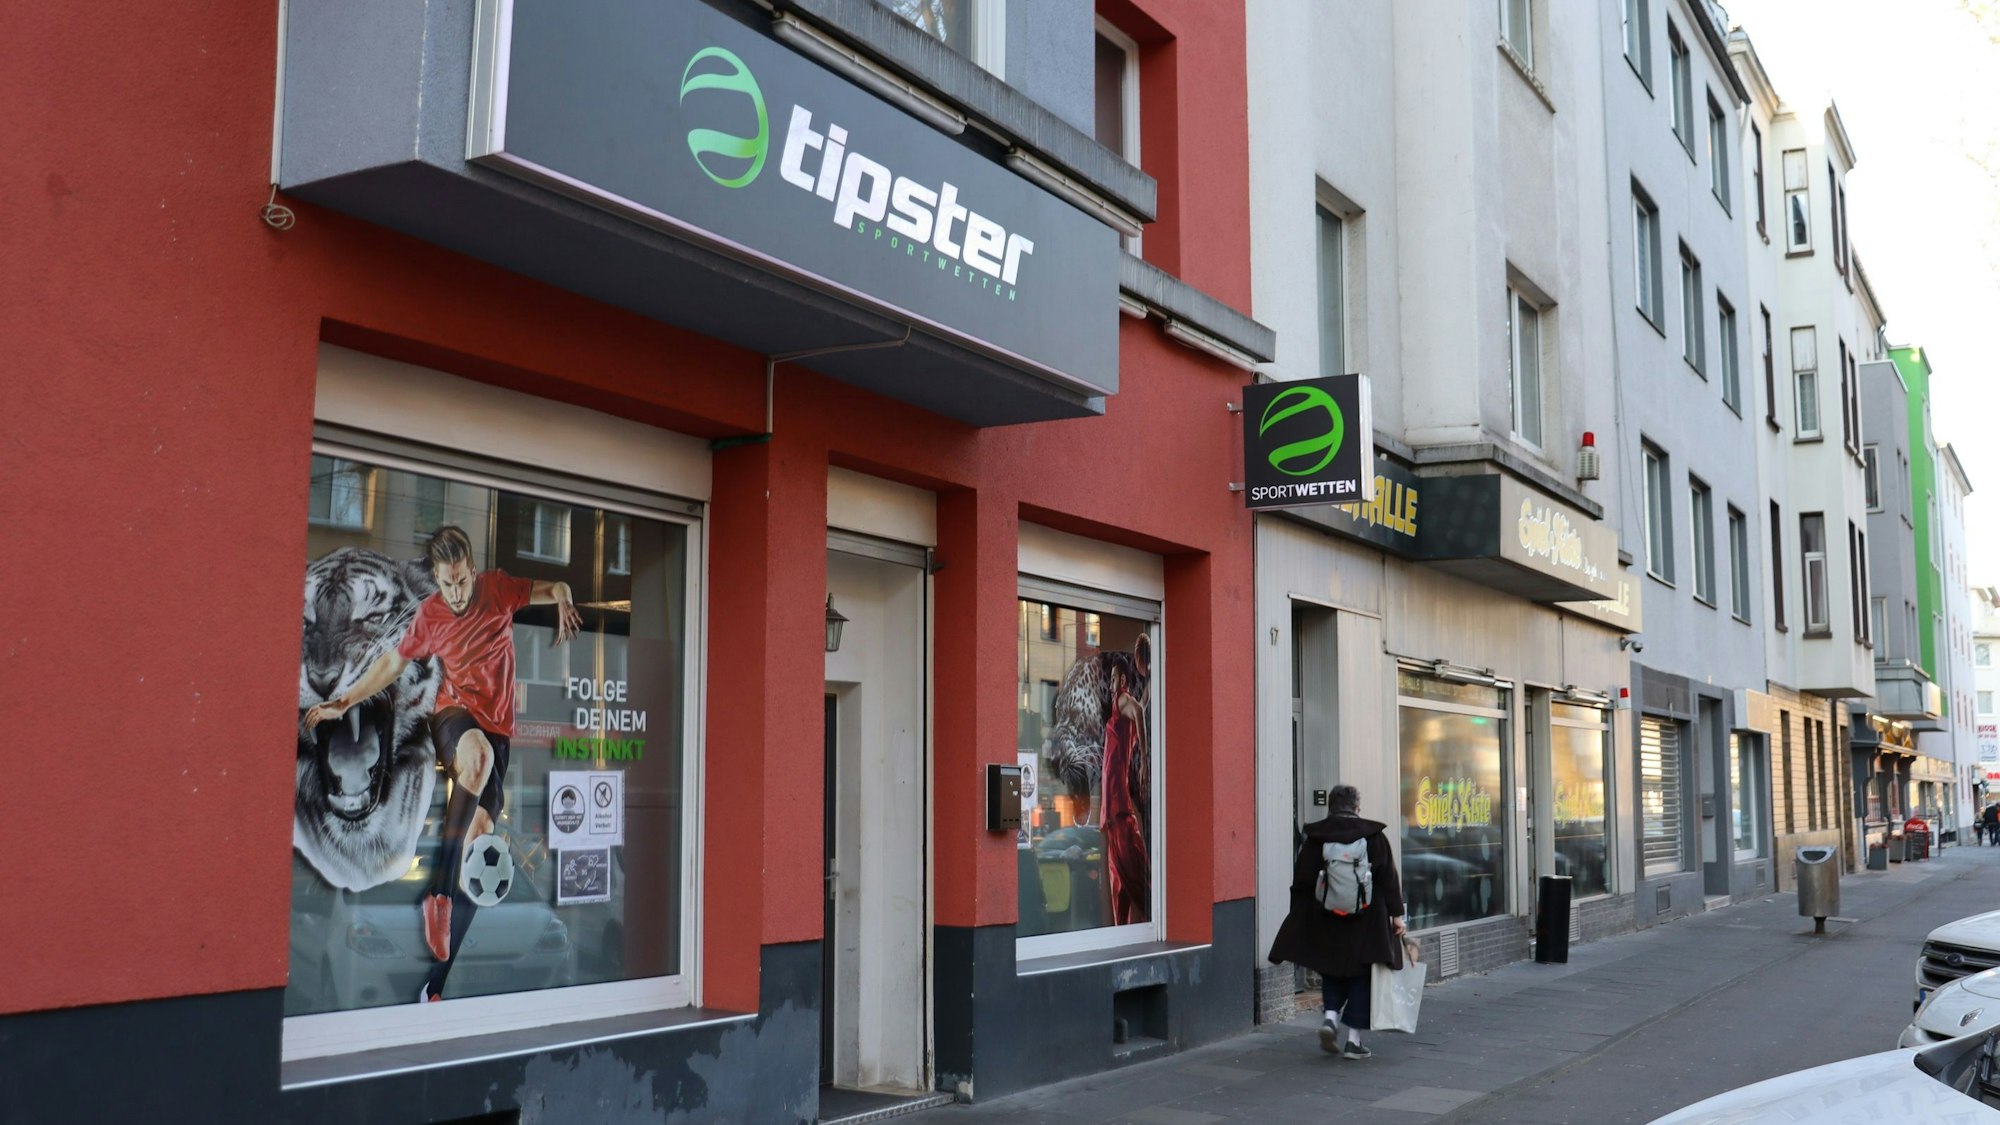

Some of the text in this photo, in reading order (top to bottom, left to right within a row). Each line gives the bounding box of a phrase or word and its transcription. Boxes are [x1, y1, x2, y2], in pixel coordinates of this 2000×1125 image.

[780, 104, 1034, 286] tipster
[858, 221, 1017, 302] SPORTWETTEN
[1251, 478, 1357, 501] SPORTWETTEN
[1270, 626, 1279, 646] 17
[567, 677, 627, 702] FOLGE
[576, 707, 647, 732] DEINEM
[555, 735, 646, 762] INSTINKT
[1415, 776, 1453, 836] Spiel
[1453, 777, 1491, 833] Kiste
